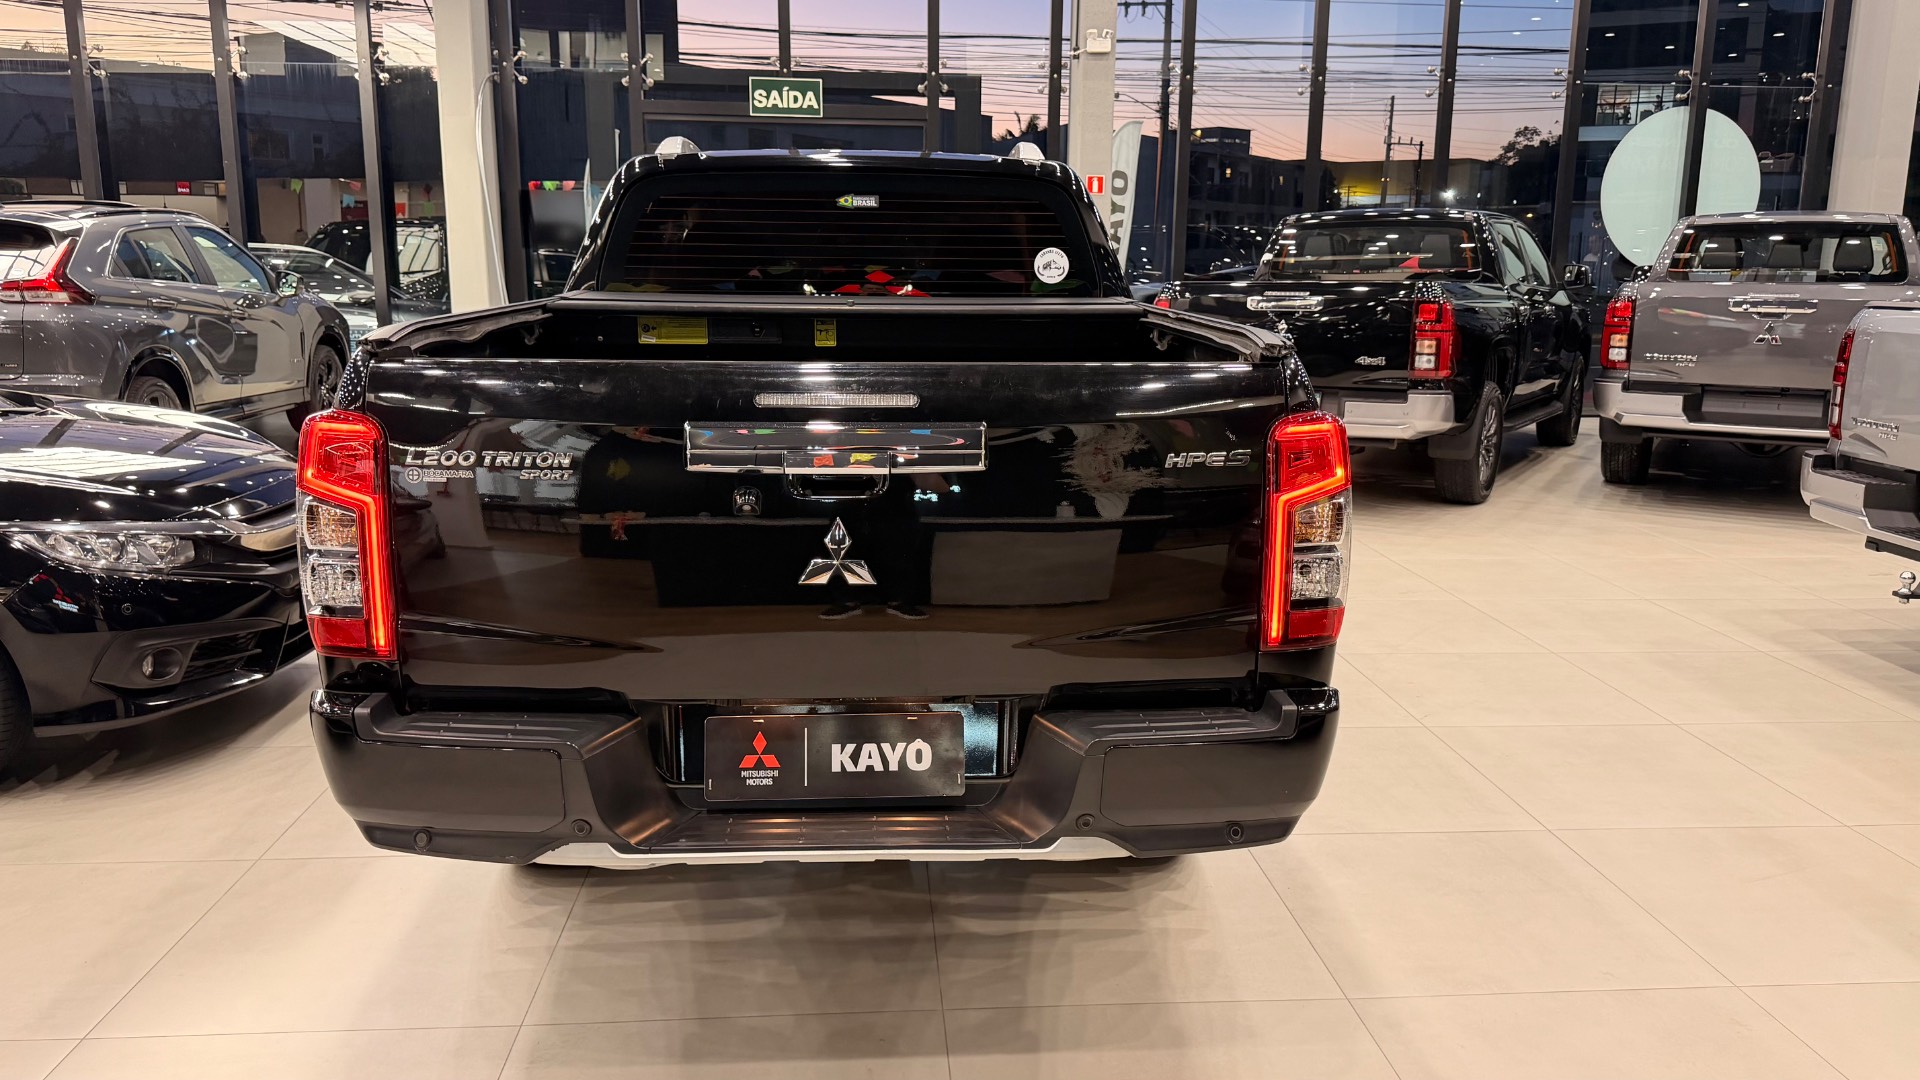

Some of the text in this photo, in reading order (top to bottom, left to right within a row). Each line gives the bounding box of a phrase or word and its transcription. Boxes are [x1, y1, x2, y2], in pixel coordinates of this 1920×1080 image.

[753, 86, 819, 109] SAÍDA
[1110, 169, 1129, 256] AYO
[405, 448, 573, 468] L200 TRITON
[519, 469, 573, 481] SPORT
[741, 769, 779, 778] MITSUBISHI
[746, 778, 773, 786] MOTORS
